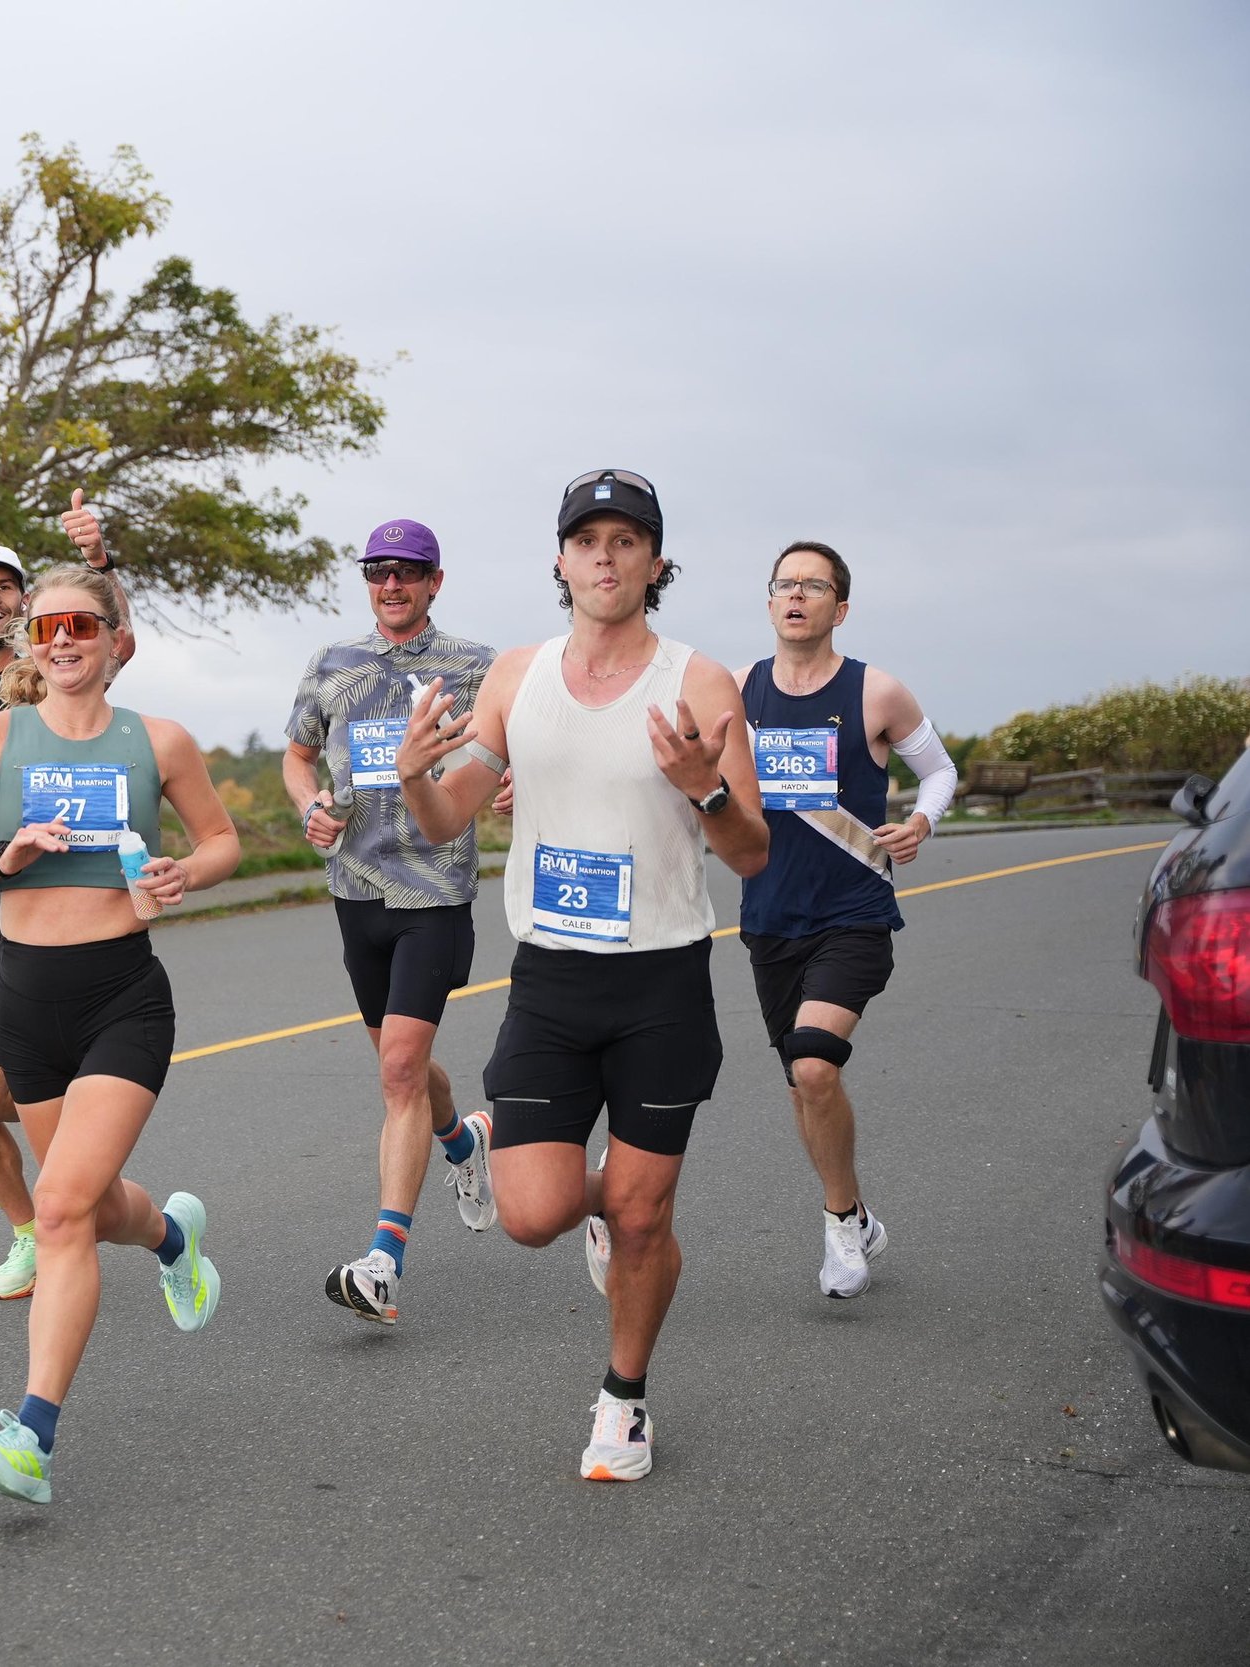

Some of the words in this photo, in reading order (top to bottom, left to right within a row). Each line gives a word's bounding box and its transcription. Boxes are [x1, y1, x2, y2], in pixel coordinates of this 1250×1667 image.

[354, 726, 385, 741] RVM
[759, 736, 792, 748] RVM
[361, 747, 397, 766] 335
[765, 756, 816, 775] 3463
[30, 773, 72, 788] RVM
[781, 783, 809, 791] HAYDN
[55, 798, 86, 821] 27
[58, 834, 95, 842] ALISON
[540, 853, 578, 875] RVM
[579, 866, 617, 876] MARATHON
[557, 884, 589, 909] 23
[562, 919, 592, 930] CALEB
